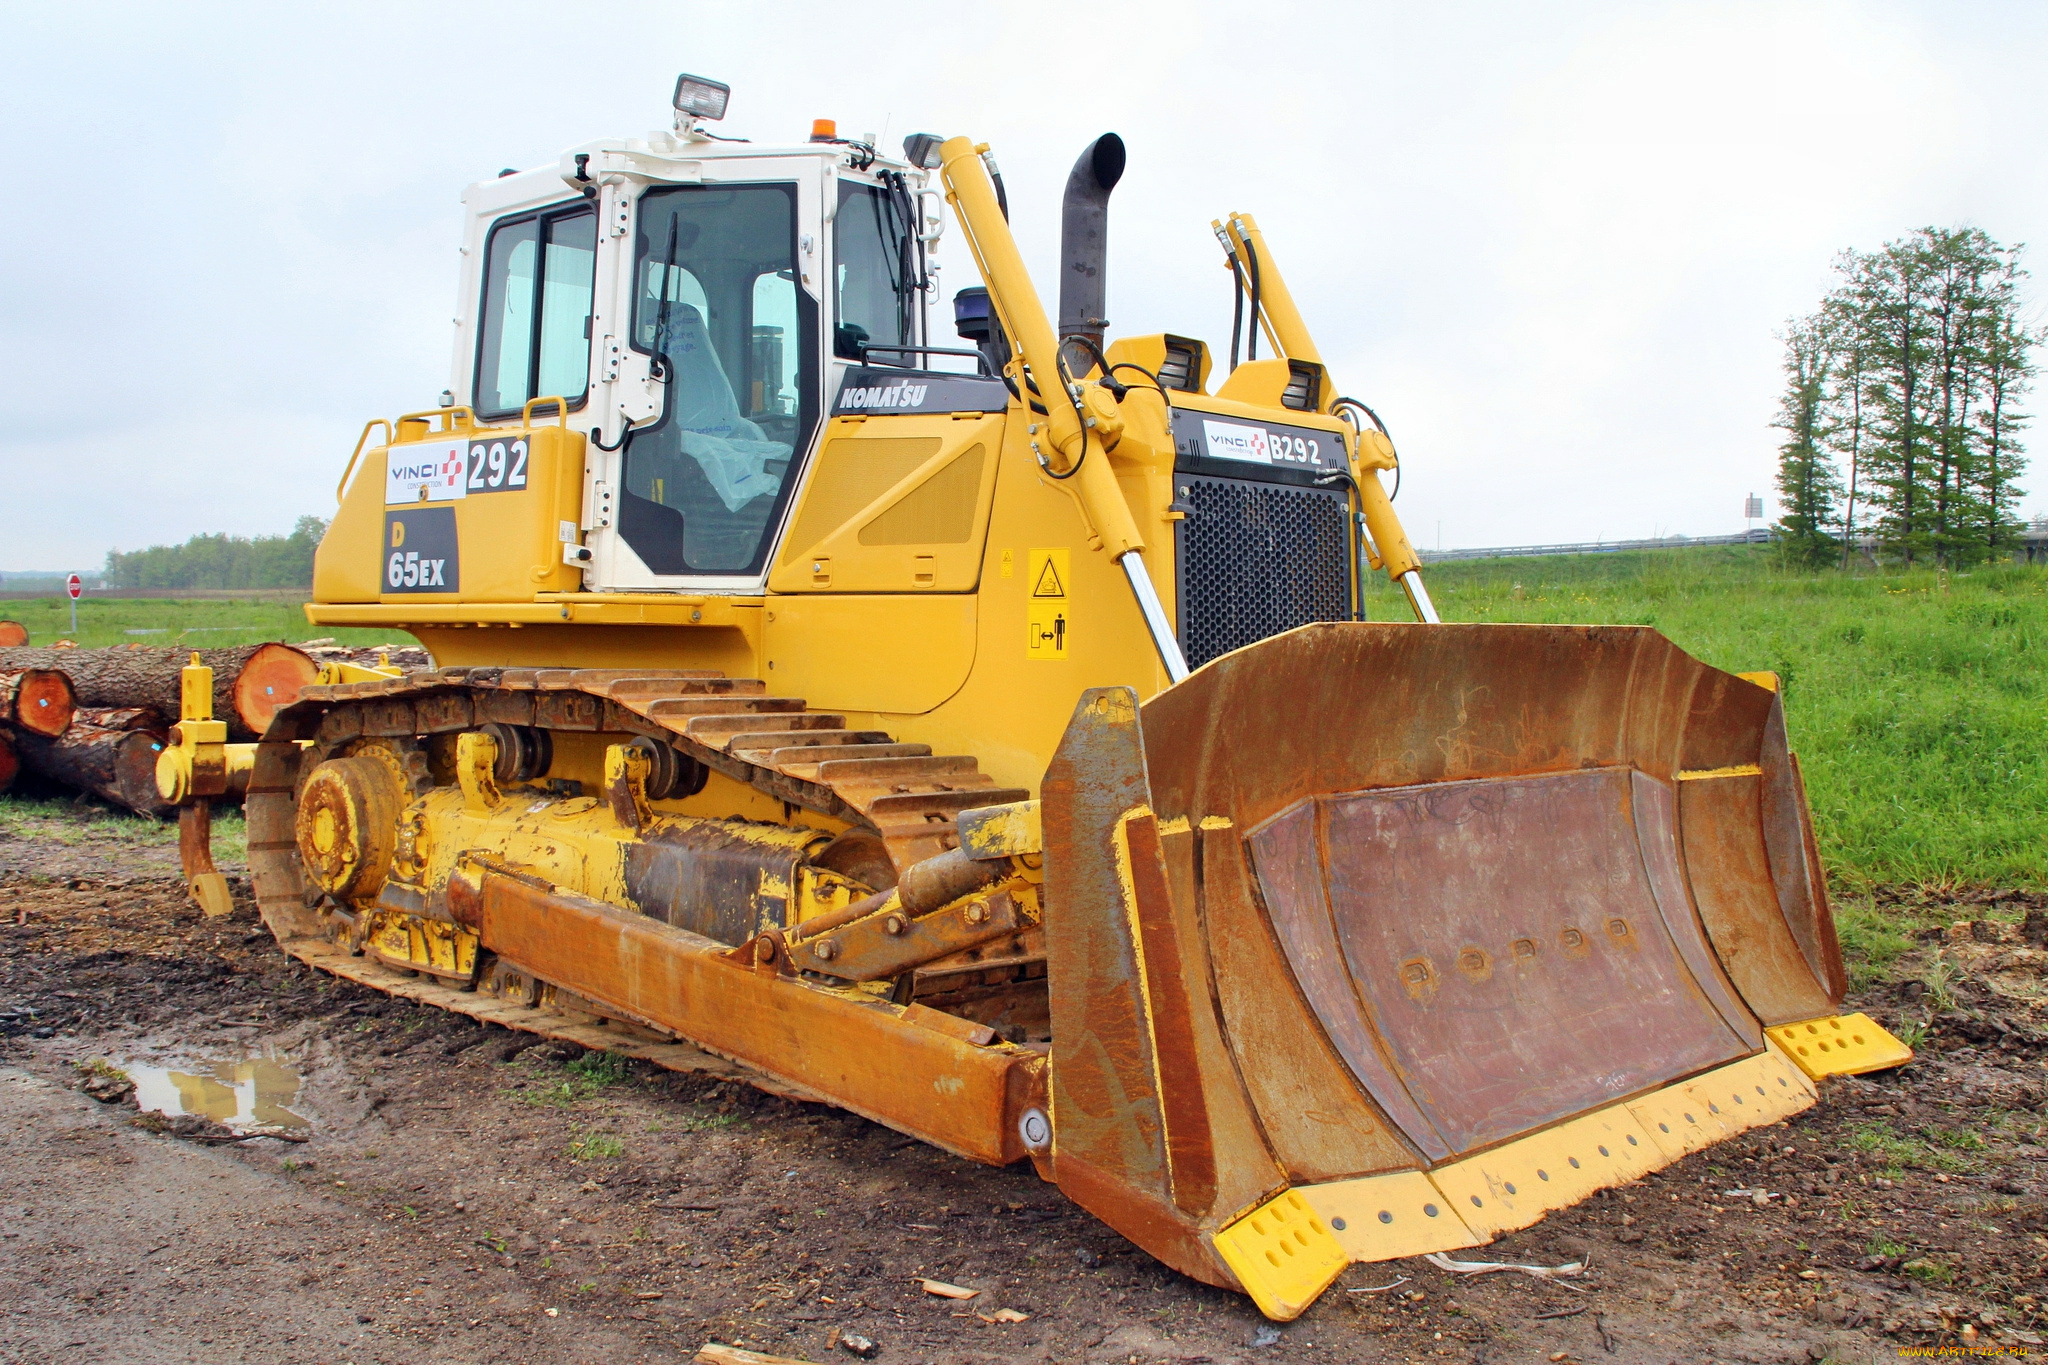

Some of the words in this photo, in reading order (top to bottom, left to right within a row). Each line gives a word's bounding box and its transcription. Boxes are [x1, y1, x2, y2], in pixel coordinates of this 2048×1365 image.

[839, 379, 928, 409] KOMATSU
[1211, 435, 1249, 448] VINCI
[1268, 434, 1322, 465] B292
[392, 463, 438, 480] VINCI
[468, 440, 528, 489] 292
[391, 521, 405, 548] D
[388, 551, 446, 588] 65EX
